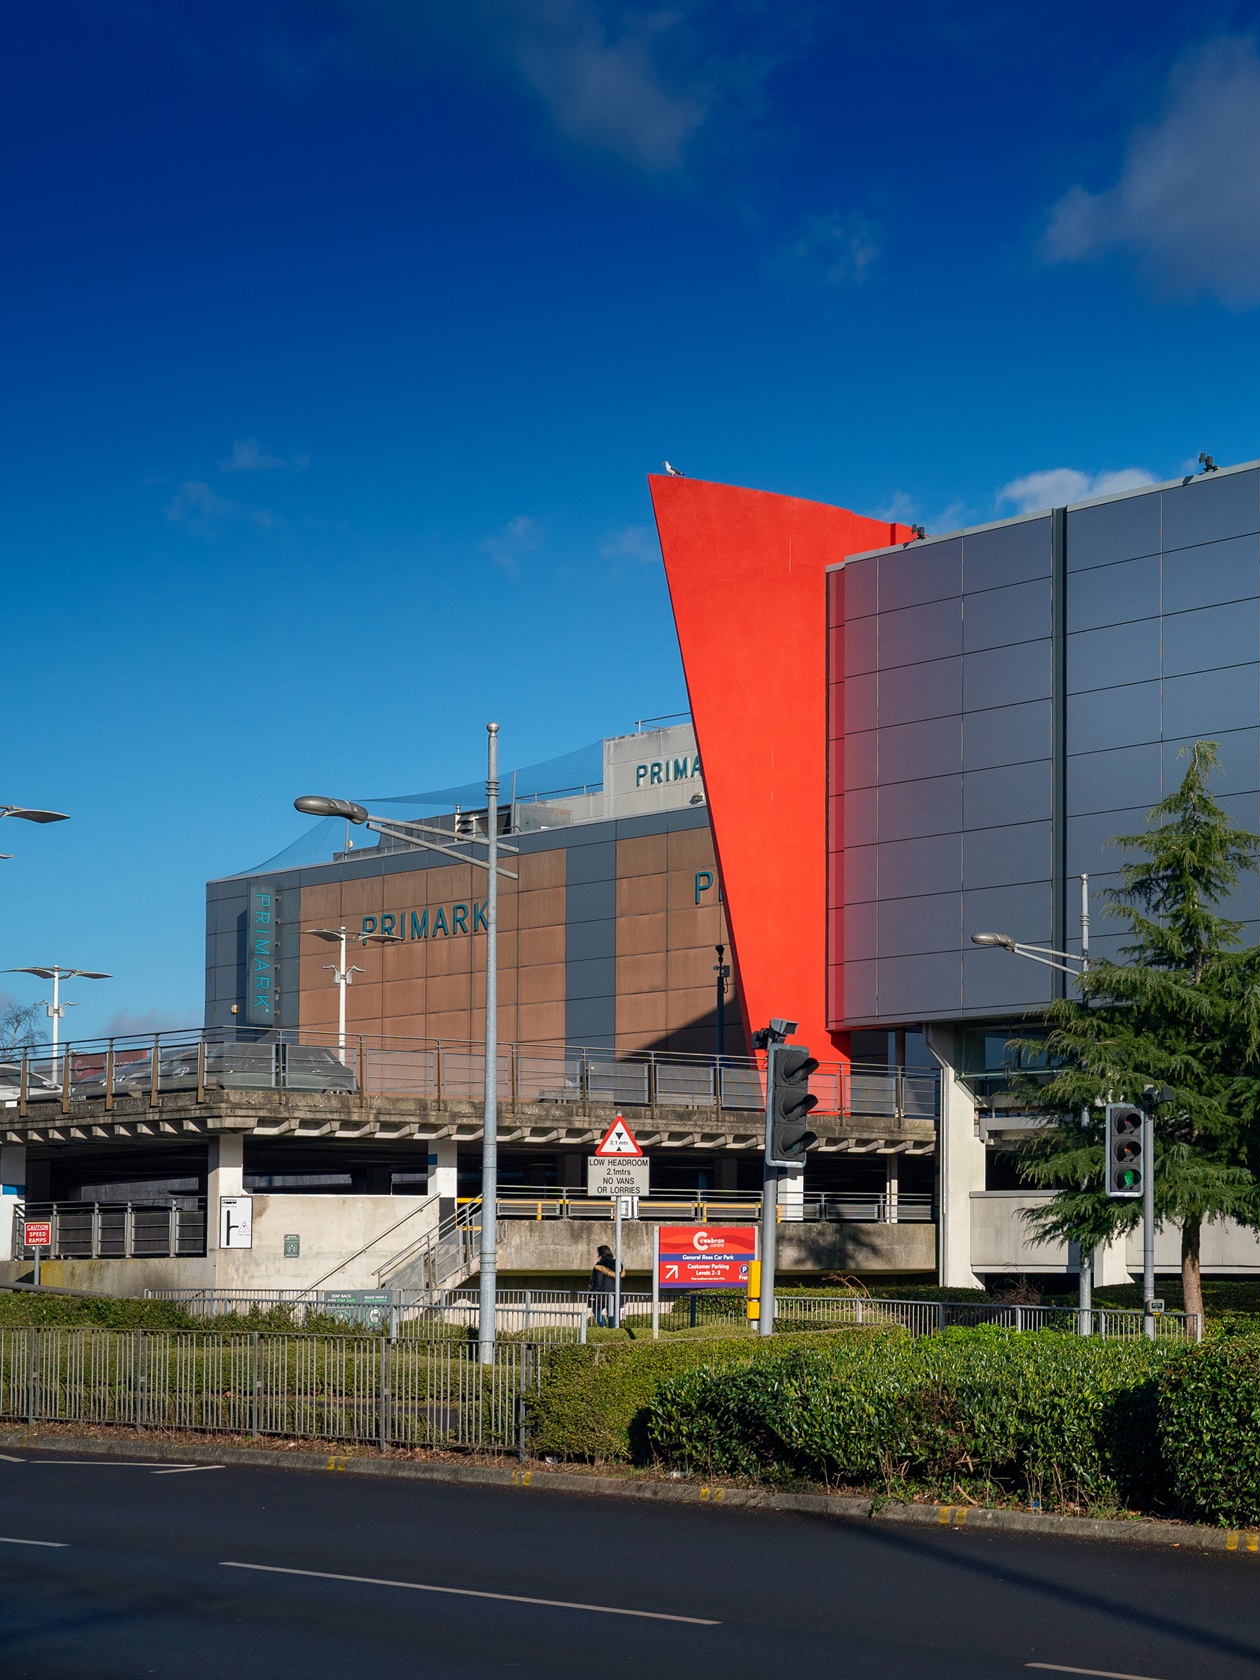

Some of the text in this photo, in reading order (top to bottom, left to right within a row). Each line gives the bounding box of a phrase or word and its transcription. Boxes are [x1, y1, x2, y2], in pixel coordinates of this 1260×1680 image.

[363, 900, 488, 946] PRIMARK
[254, 893, 270, 1008] PRIMARK
[610, 1186, 640, 1194] LORRIES
[616, 1177, 634, 1185] VANS
